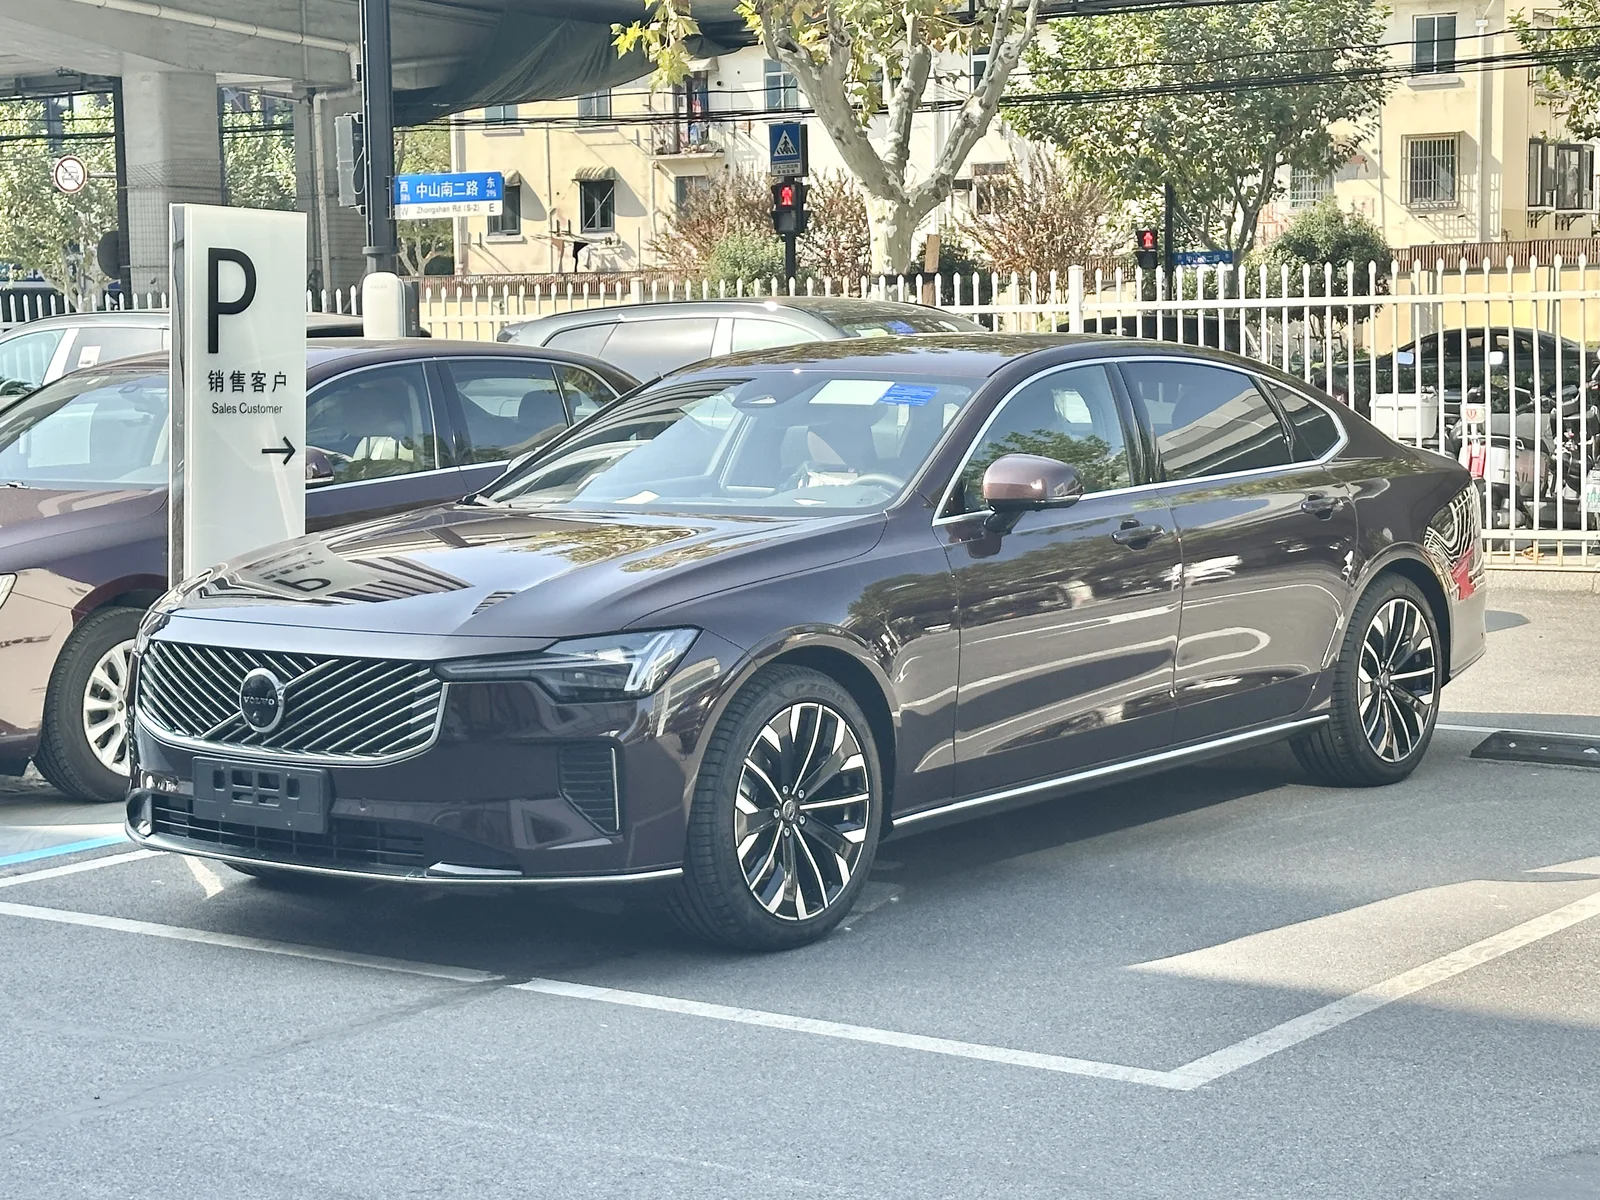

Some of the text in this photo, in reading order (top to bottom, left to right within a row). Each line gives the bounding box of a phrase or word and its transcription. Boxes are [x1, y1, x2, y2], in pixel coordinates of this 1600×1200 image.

[400, 176, 496, 198] 西 中山南二路 东
[400, 207, 409, 216] W
[416, 204, 450, 214] Zhongshan
[452, 204, 461, 212] Rd
[489, 203, 495, 212] E
[208, 247, 257, 354] P
[208, 370, 287, 393] 销售客户
[211, 402, 283, 414] Sales Customer
[243, 696, 275, 706] VOLVO
